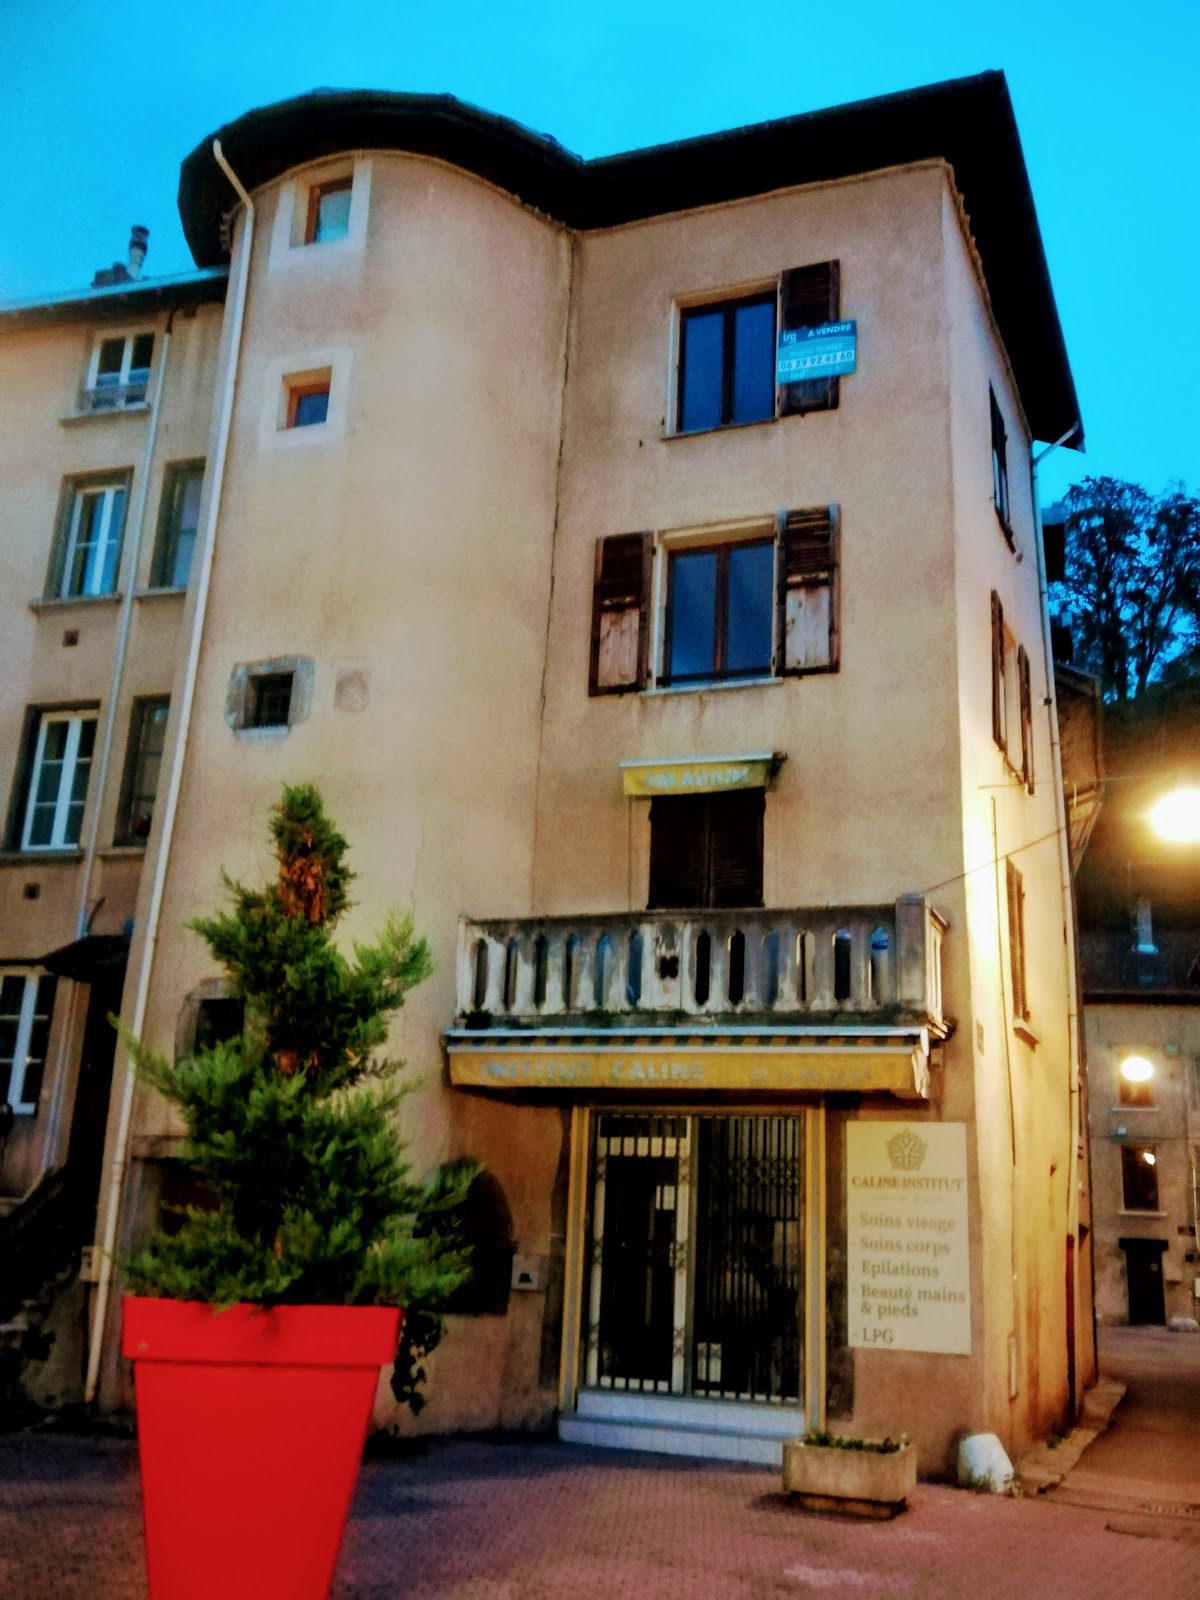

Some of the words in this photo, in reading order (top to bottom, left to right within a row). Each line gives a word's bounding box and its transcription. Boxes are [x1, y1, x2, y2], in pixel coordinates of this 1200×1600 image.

[816, 323, 852, 336] VENDRE
[780, 361, 792, 370] 06
[796, 359, 807, 368] 29
[840, 351, 853, 360] 60
[611, 1060, 704, 1081] CALINE
[852, 1175, 899, 1189] CALINE
[902, 1177, 963, 1191] INSTITUT
[860, 1211, 902, 1228] Soins
[906, 1215, 955, 1233] visage
[860, 1237, 902, 1251] Soins
[906, 1241, 950, 1257] corps
[862, 1260, 940, 1278] Epilations
[861, 1284, 913, 1300] Beauté
[918, 1287, 966, 1302] mains
[861, 1301, 871, 1315] &
[878, 1302, 918, 1319] pieds
[862, 1328, 894, 1344] LPG
